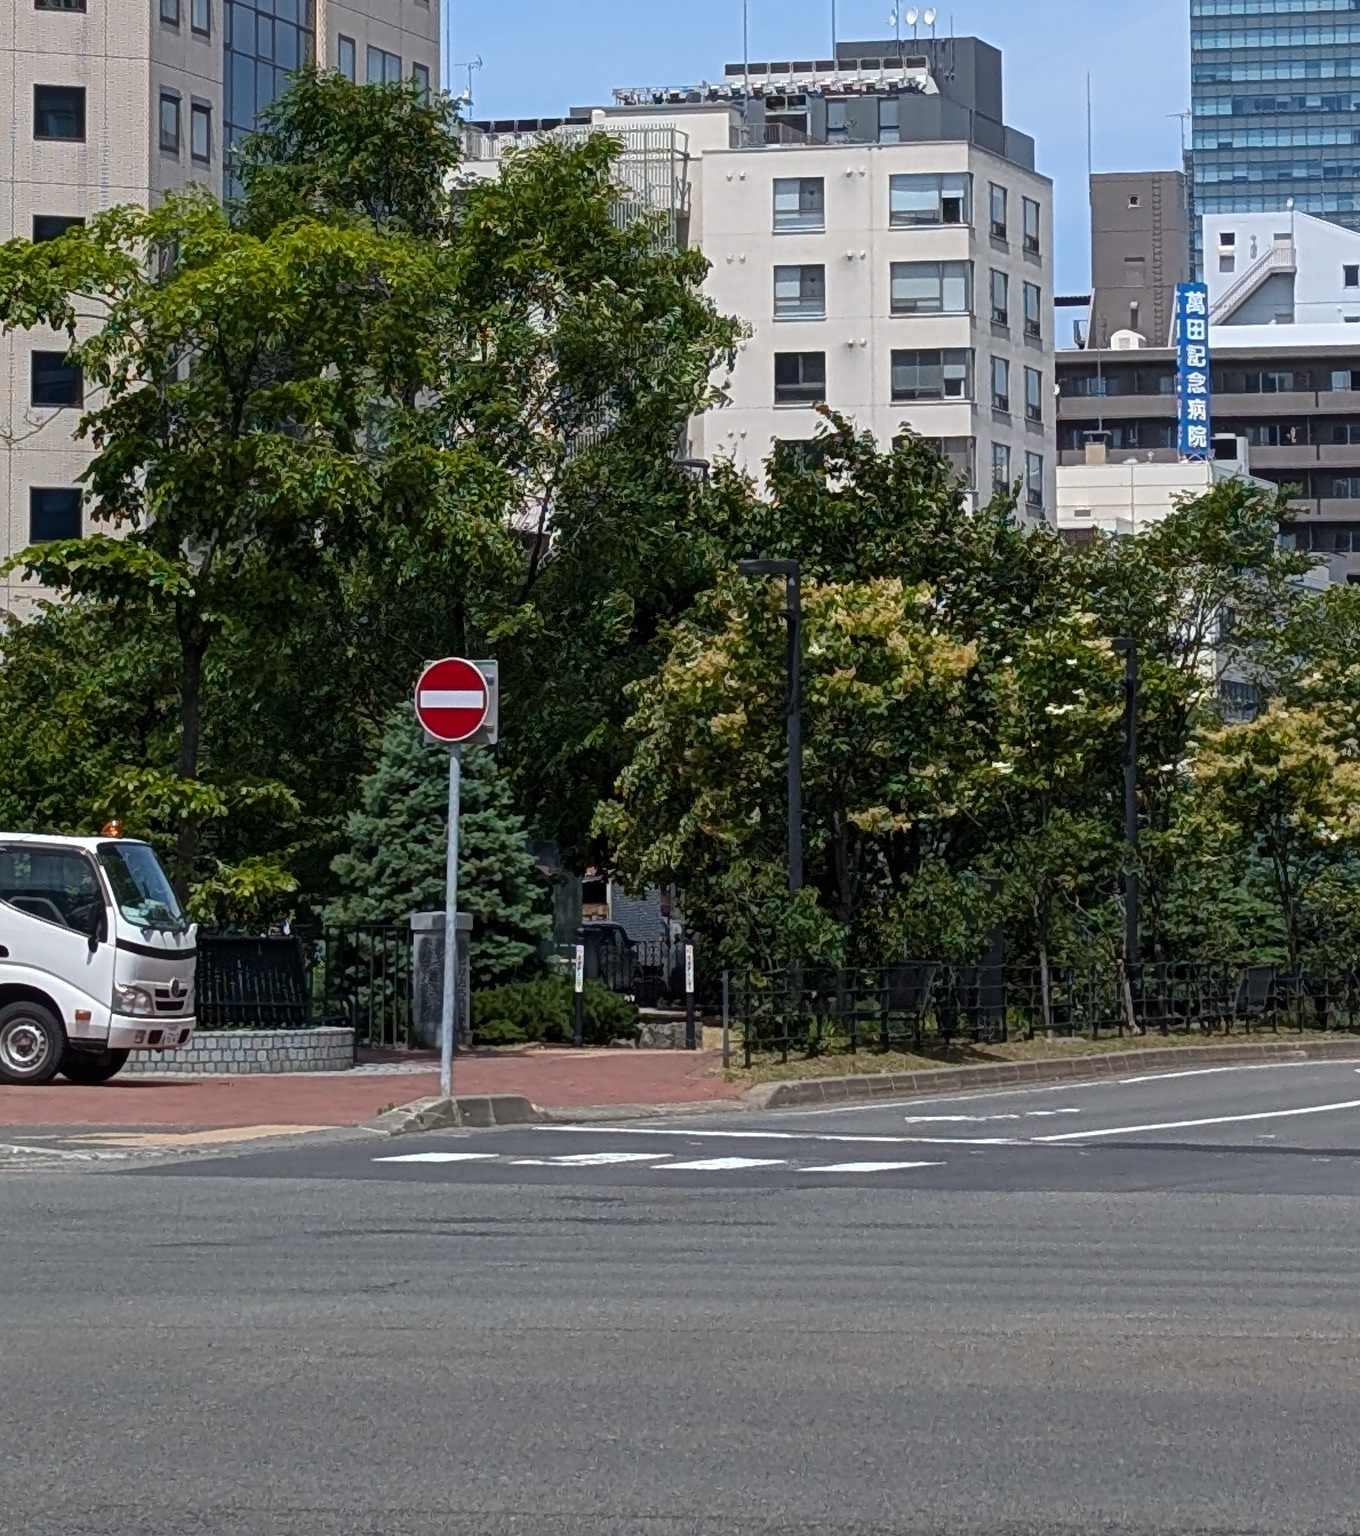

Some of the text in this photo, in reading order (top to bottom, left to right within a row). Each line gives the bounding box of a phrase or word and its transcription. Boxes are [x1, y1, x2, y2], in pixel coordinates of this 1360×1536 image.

[1185, 291, 1208, 449] 萬田記念病院
